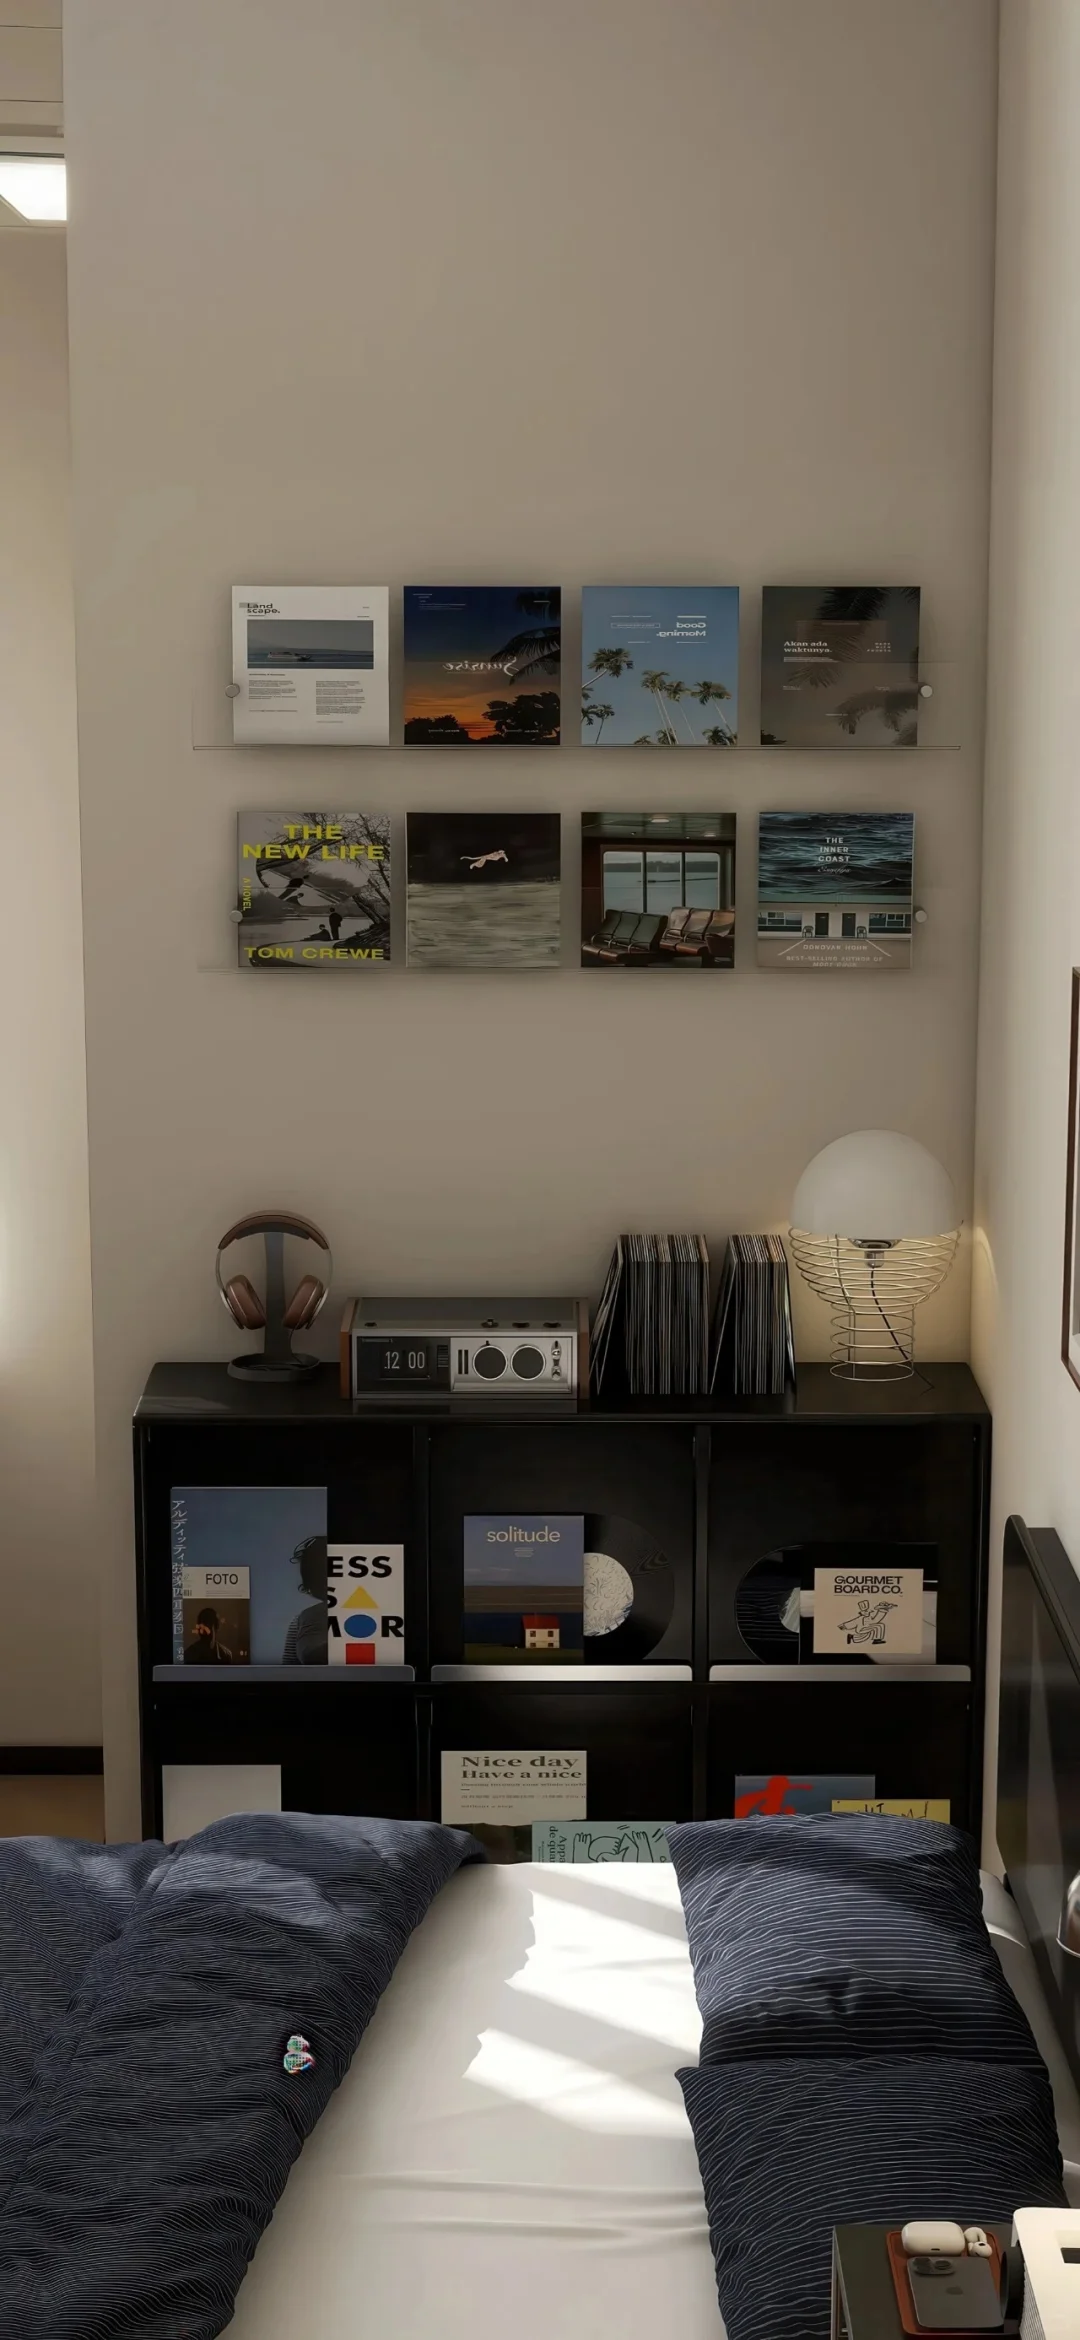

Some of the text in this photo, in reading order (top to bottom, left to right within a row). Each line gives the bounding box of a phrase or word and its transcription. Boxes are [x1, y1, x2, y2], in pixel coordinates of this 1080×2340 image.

[283, 824, 343, 840] THE
[242, 844, 385, 860] NEW LIFE
[242, 885, 252, 911] NOVEL
[244, 947, 385, 960] TOM CREWE
[385, 1351, 425, 1369] 12 00
[486, 1525, 561, 1543] solitude
[205, 1573, 239, 1585] FOTO
[834, 1575, 903, 1585] GOURMET
[834, 1585, 903, 1594] BOARD CO.
[461, 1755, 579, 1770] Nice day
[462, 1770, 515, 1779] Have
[538, 1769, 582, 1779] nice
[549, 1826, 559, 1839] de
